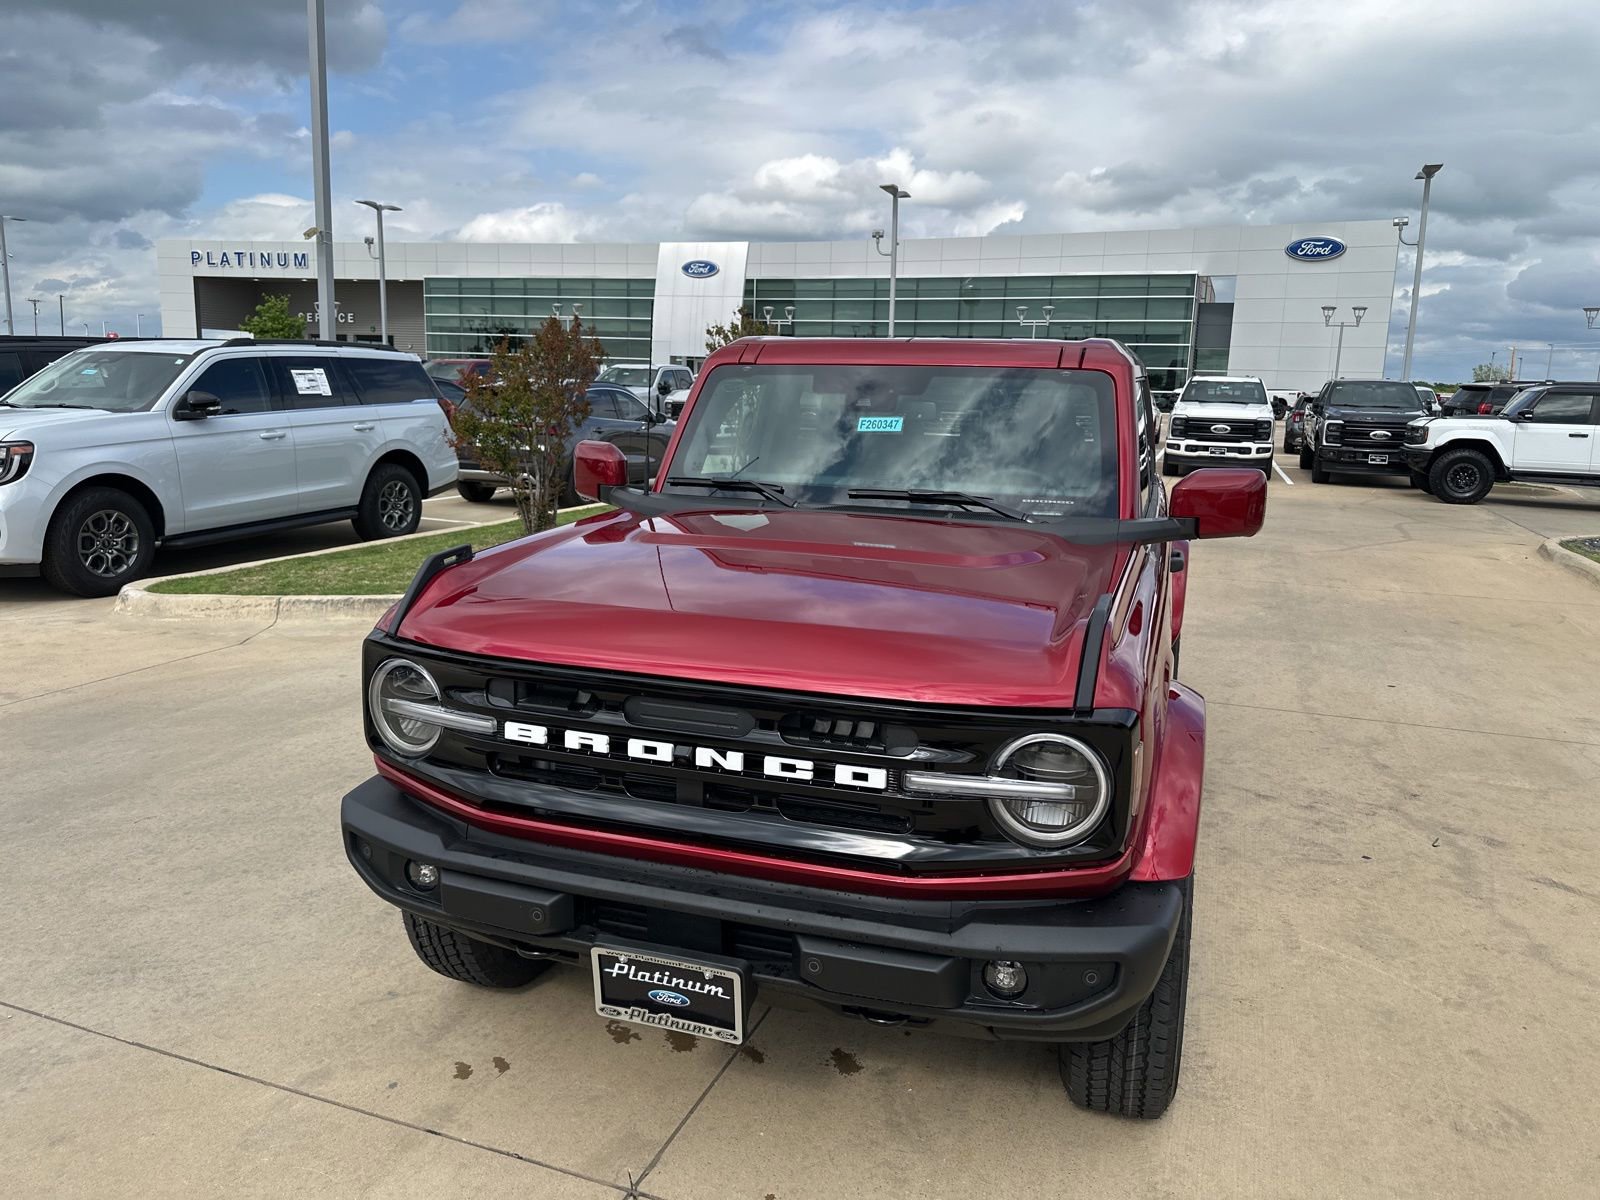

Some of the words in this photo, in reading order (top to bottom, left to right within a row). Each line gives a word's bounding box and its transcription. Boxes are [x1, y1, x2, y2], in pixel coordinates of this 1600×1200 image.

[1297, 241, 1334, 255] Ford
[191, 251, 308, 268] PLATINUM
[688, 263, 711, 273] Ford
[859, 419, 900, 430] F260347
[504, 721, 888, 790] BRONCO
[603, 962, 731, 999] Platinum
[656, 991, 683, 1005] Ford
[629, 1008, 713, 1036] Platinum
